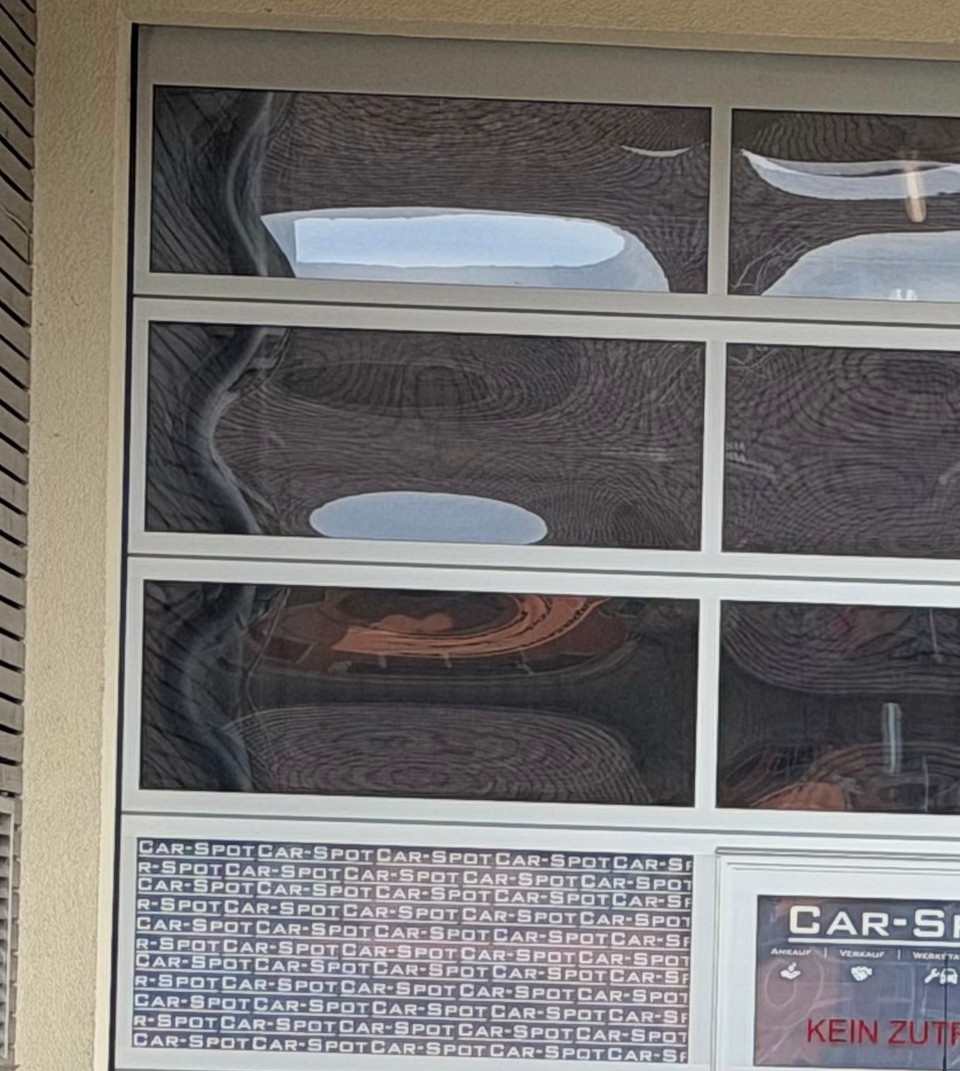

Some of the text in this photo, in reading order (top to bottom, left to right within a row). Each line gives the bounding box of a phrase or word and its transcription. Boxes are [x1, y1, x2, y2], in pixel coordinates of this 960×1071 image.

[771, 948, 811, 956] ANKAUF
[840, 949, 884, 958] VERKAUF
[807, 1018, 878, 1044] KEIN
